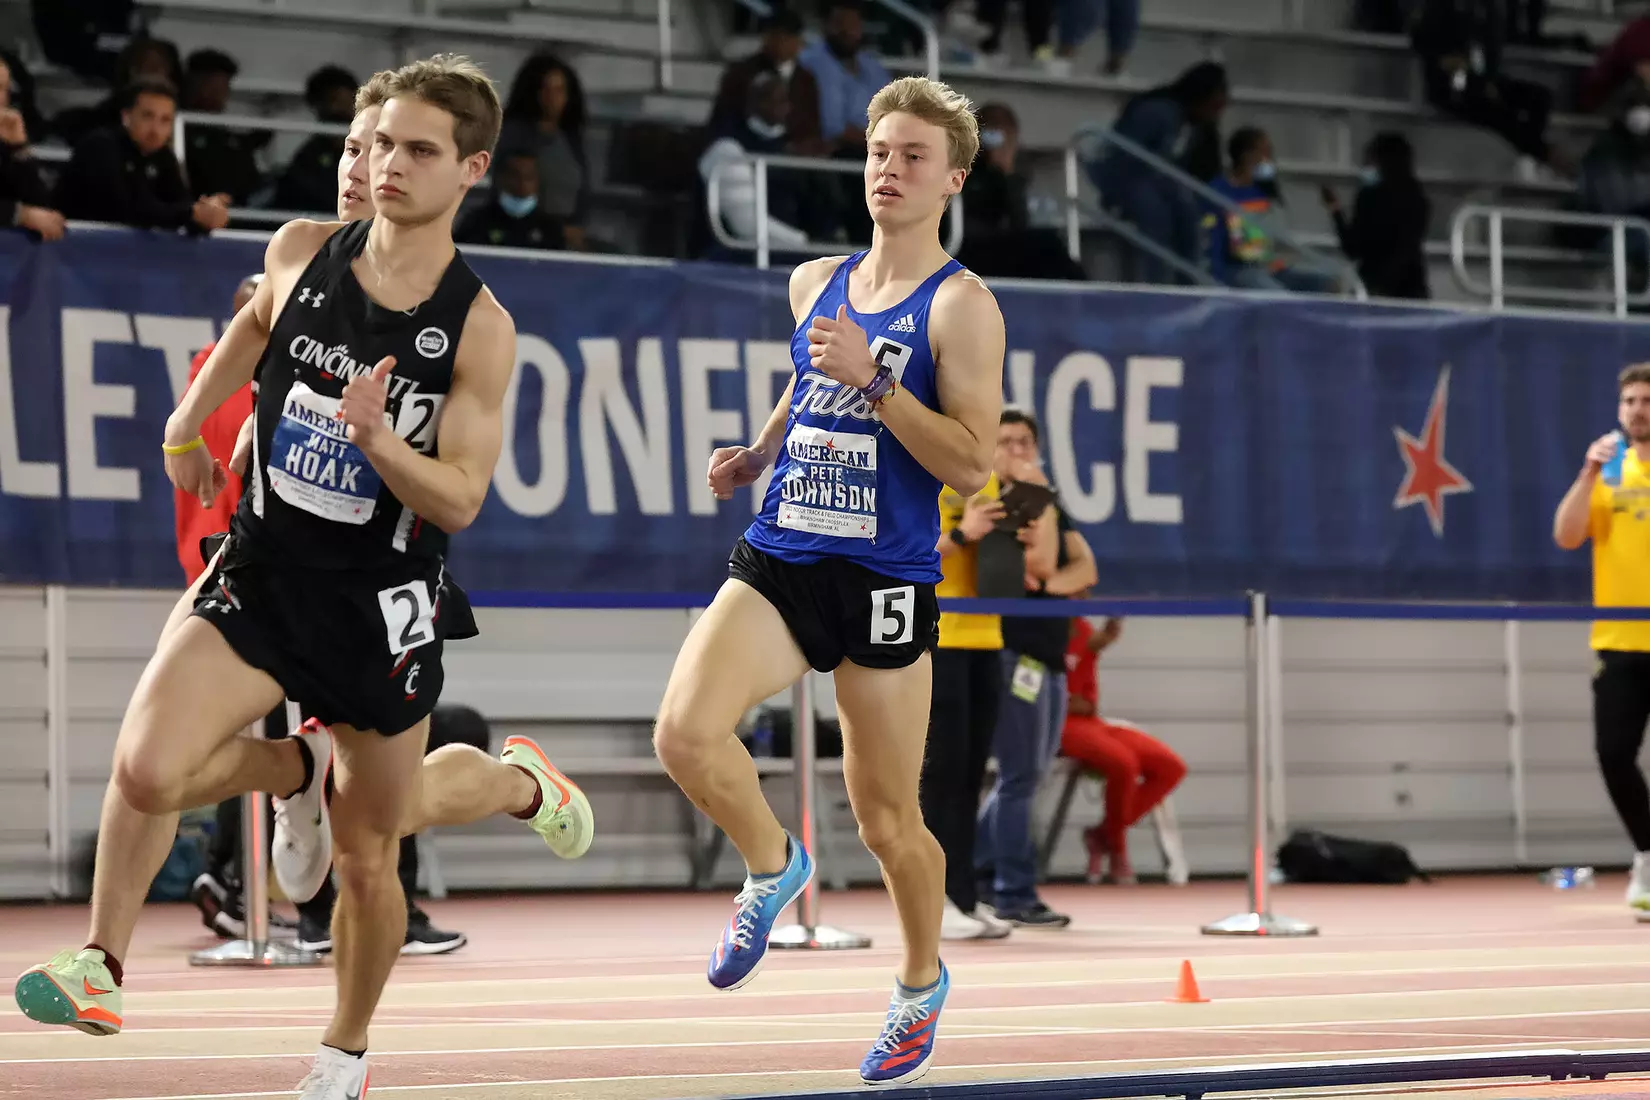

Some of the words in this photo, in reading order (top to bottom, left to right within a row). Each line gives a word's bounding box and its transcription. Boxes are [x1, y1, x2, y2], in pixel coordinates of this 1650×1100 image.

[888, 323, 917, 333] adidas
[793, 371, 883, 423] Tuls
[288, 400, 350, 439] AMERI
[404, 398, 434, 449] 2
[307, 432, 347, 458] MATT
[790, 441, 869, 467] AMERICAN
[285, 443, 362, 492] HOAK
[810, 466, 843, 481] PETE
[781, 477, 876, 512] JOHNSON
[391, 590, 426, 647] 2
[882, 591, 906, 642] 5
